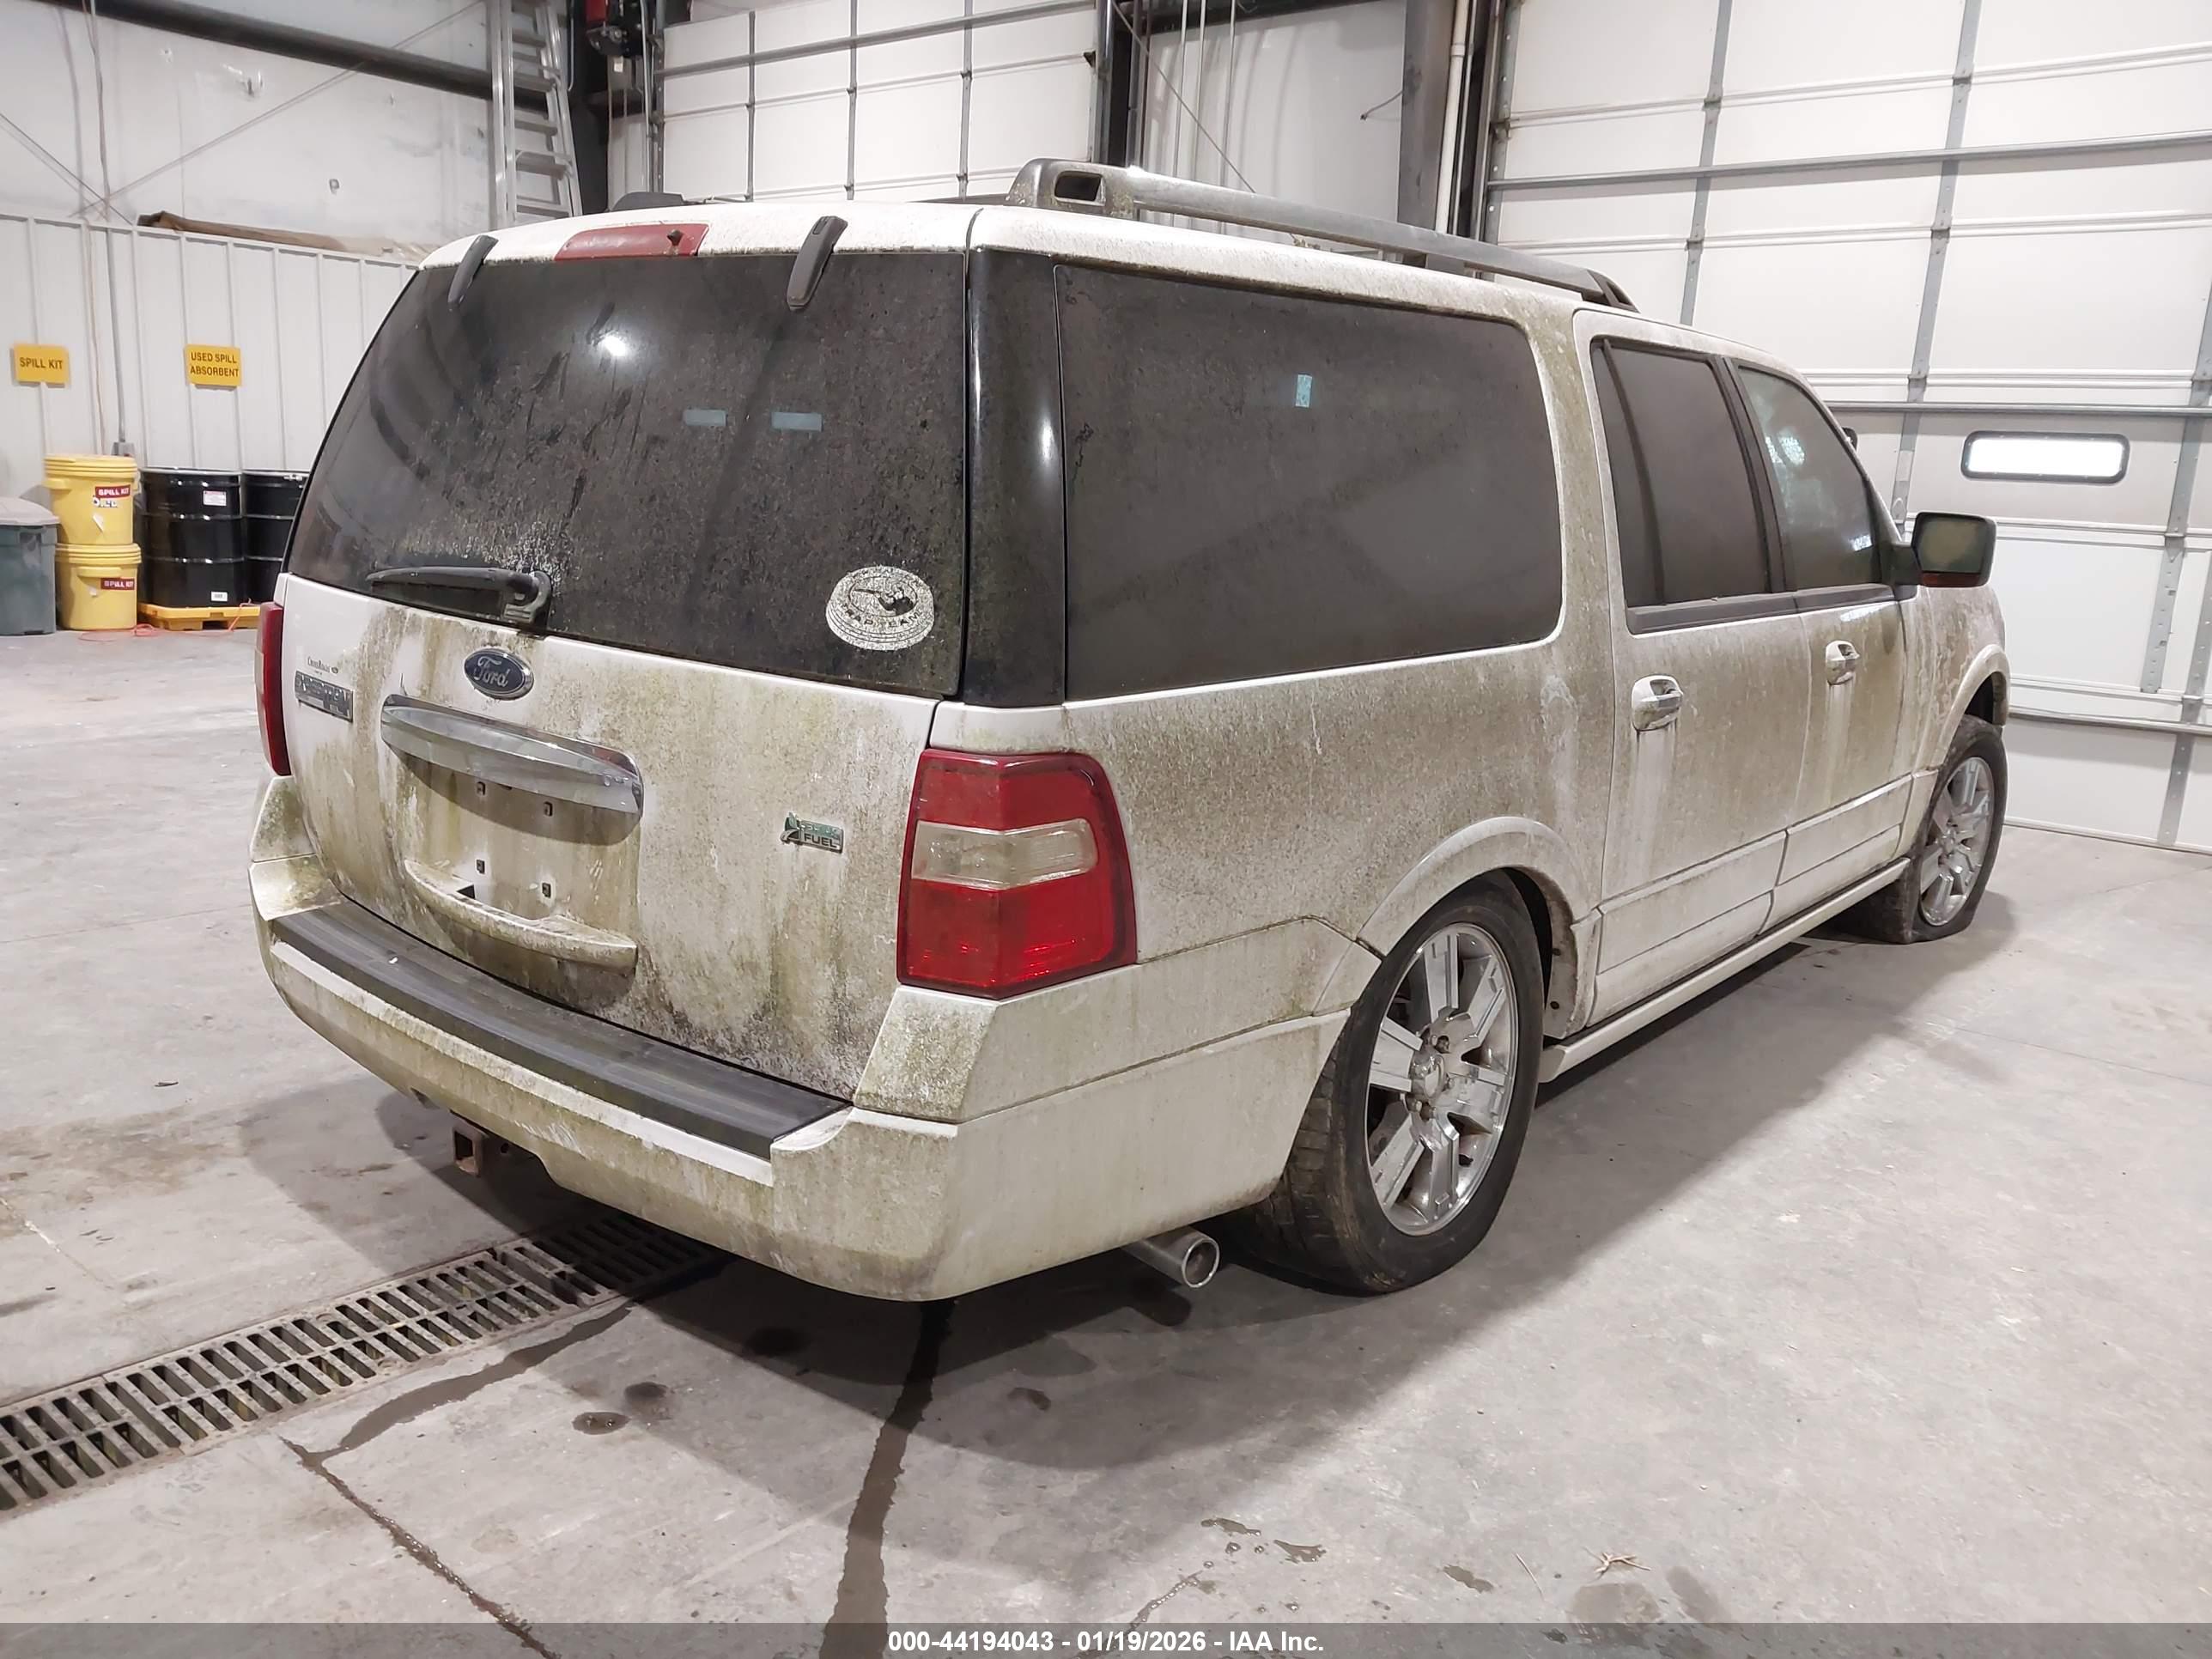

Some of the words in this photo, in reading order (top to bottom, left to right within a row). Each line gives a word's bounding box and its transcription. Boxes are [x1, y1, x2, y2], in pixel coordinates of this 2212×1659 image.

[19, 357, 46, 369] SPILL
[48, 359, 64, 370] KIT
[191, 352, 213, 362] USED
[215, 353, 237, 364] SPILL
[190, 365, 240, 378] ABSORBENT
[473, 655, 511, 687] Ford
[804, 832, 838, 848] FUEL
